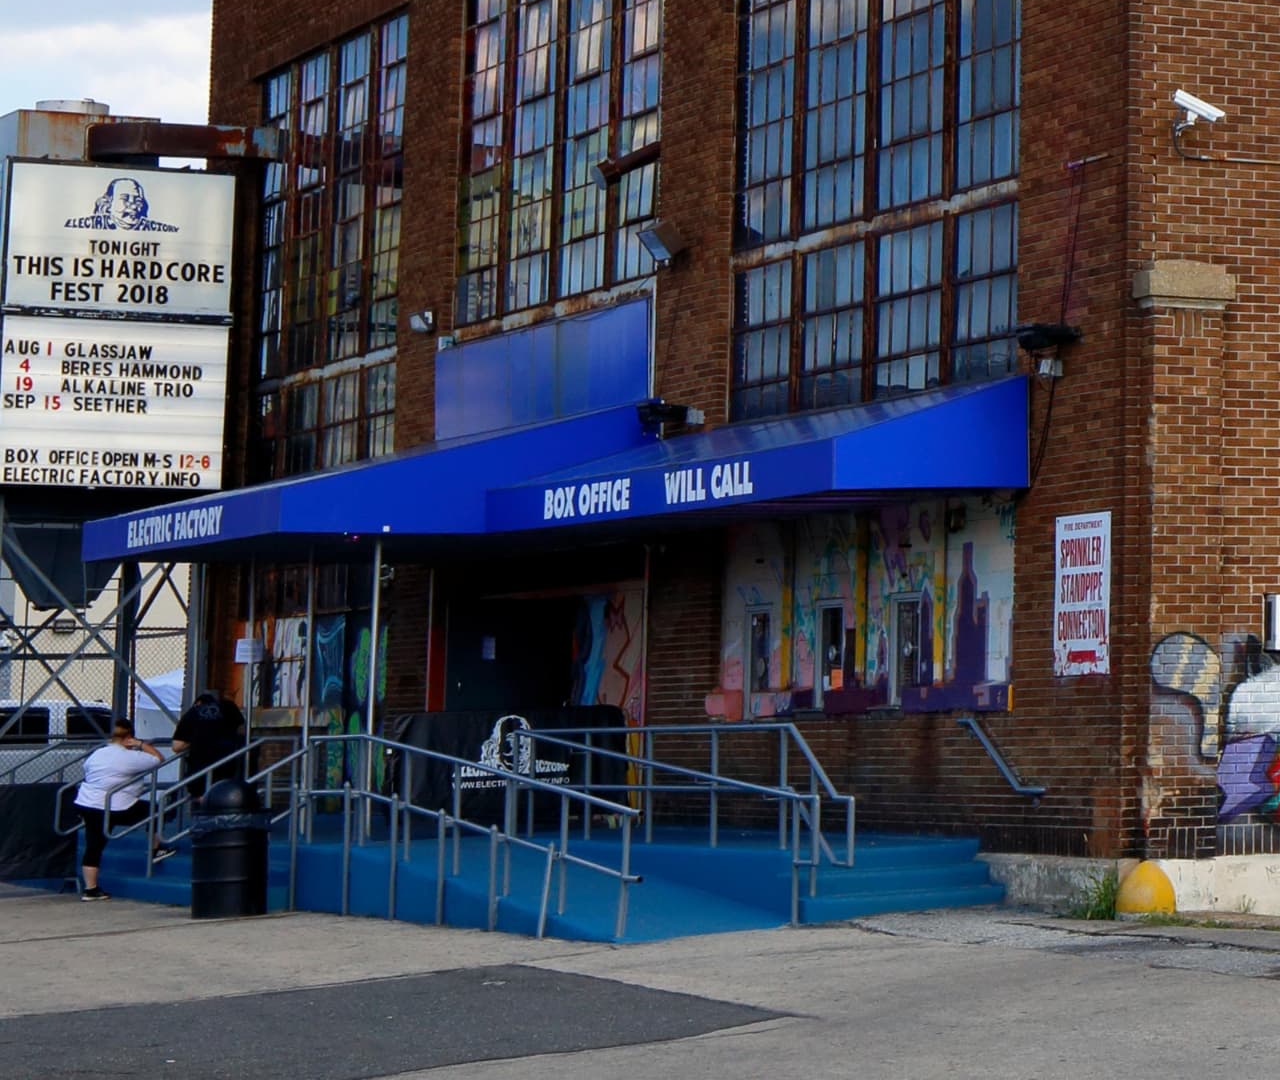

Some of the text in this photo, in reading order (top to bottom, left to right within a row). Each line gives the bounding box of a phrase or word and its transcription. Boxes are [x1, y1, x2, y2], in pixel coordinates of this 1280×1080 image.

[64, 215, 180, 233] ELECTRIC FACTORY
[89, 239, 161, 256] TONIGHT
[12, 255, 225, 283] THIS IS HARDCORE
[51, 281, 169, 305] FEST 2018
[4, 339, 153, 360] AUG 1 GLASSJAW
[19, 358, 203, 381] 4 BERES HAMMOND
[15, 376, 194, 398] 19 ALKALINE TRIO
[3, 393, 147, 414] SEP 15 SEETHER
[4, 448, 211, 469] BOX OFFICE OPEN M-S 12-6
[664, 461, 753, 504] WILL CALL
[543, 477, 631, 520] BOX OFFICE
[127, 505, 223, 549] ELECTRIC FACTORY
[1074, 520, 1103, 530] DEPARTMENT
[1060, 572, 1104, 604] STANDPIPE
[1058, 609, 1106, 641] CONNECTION
